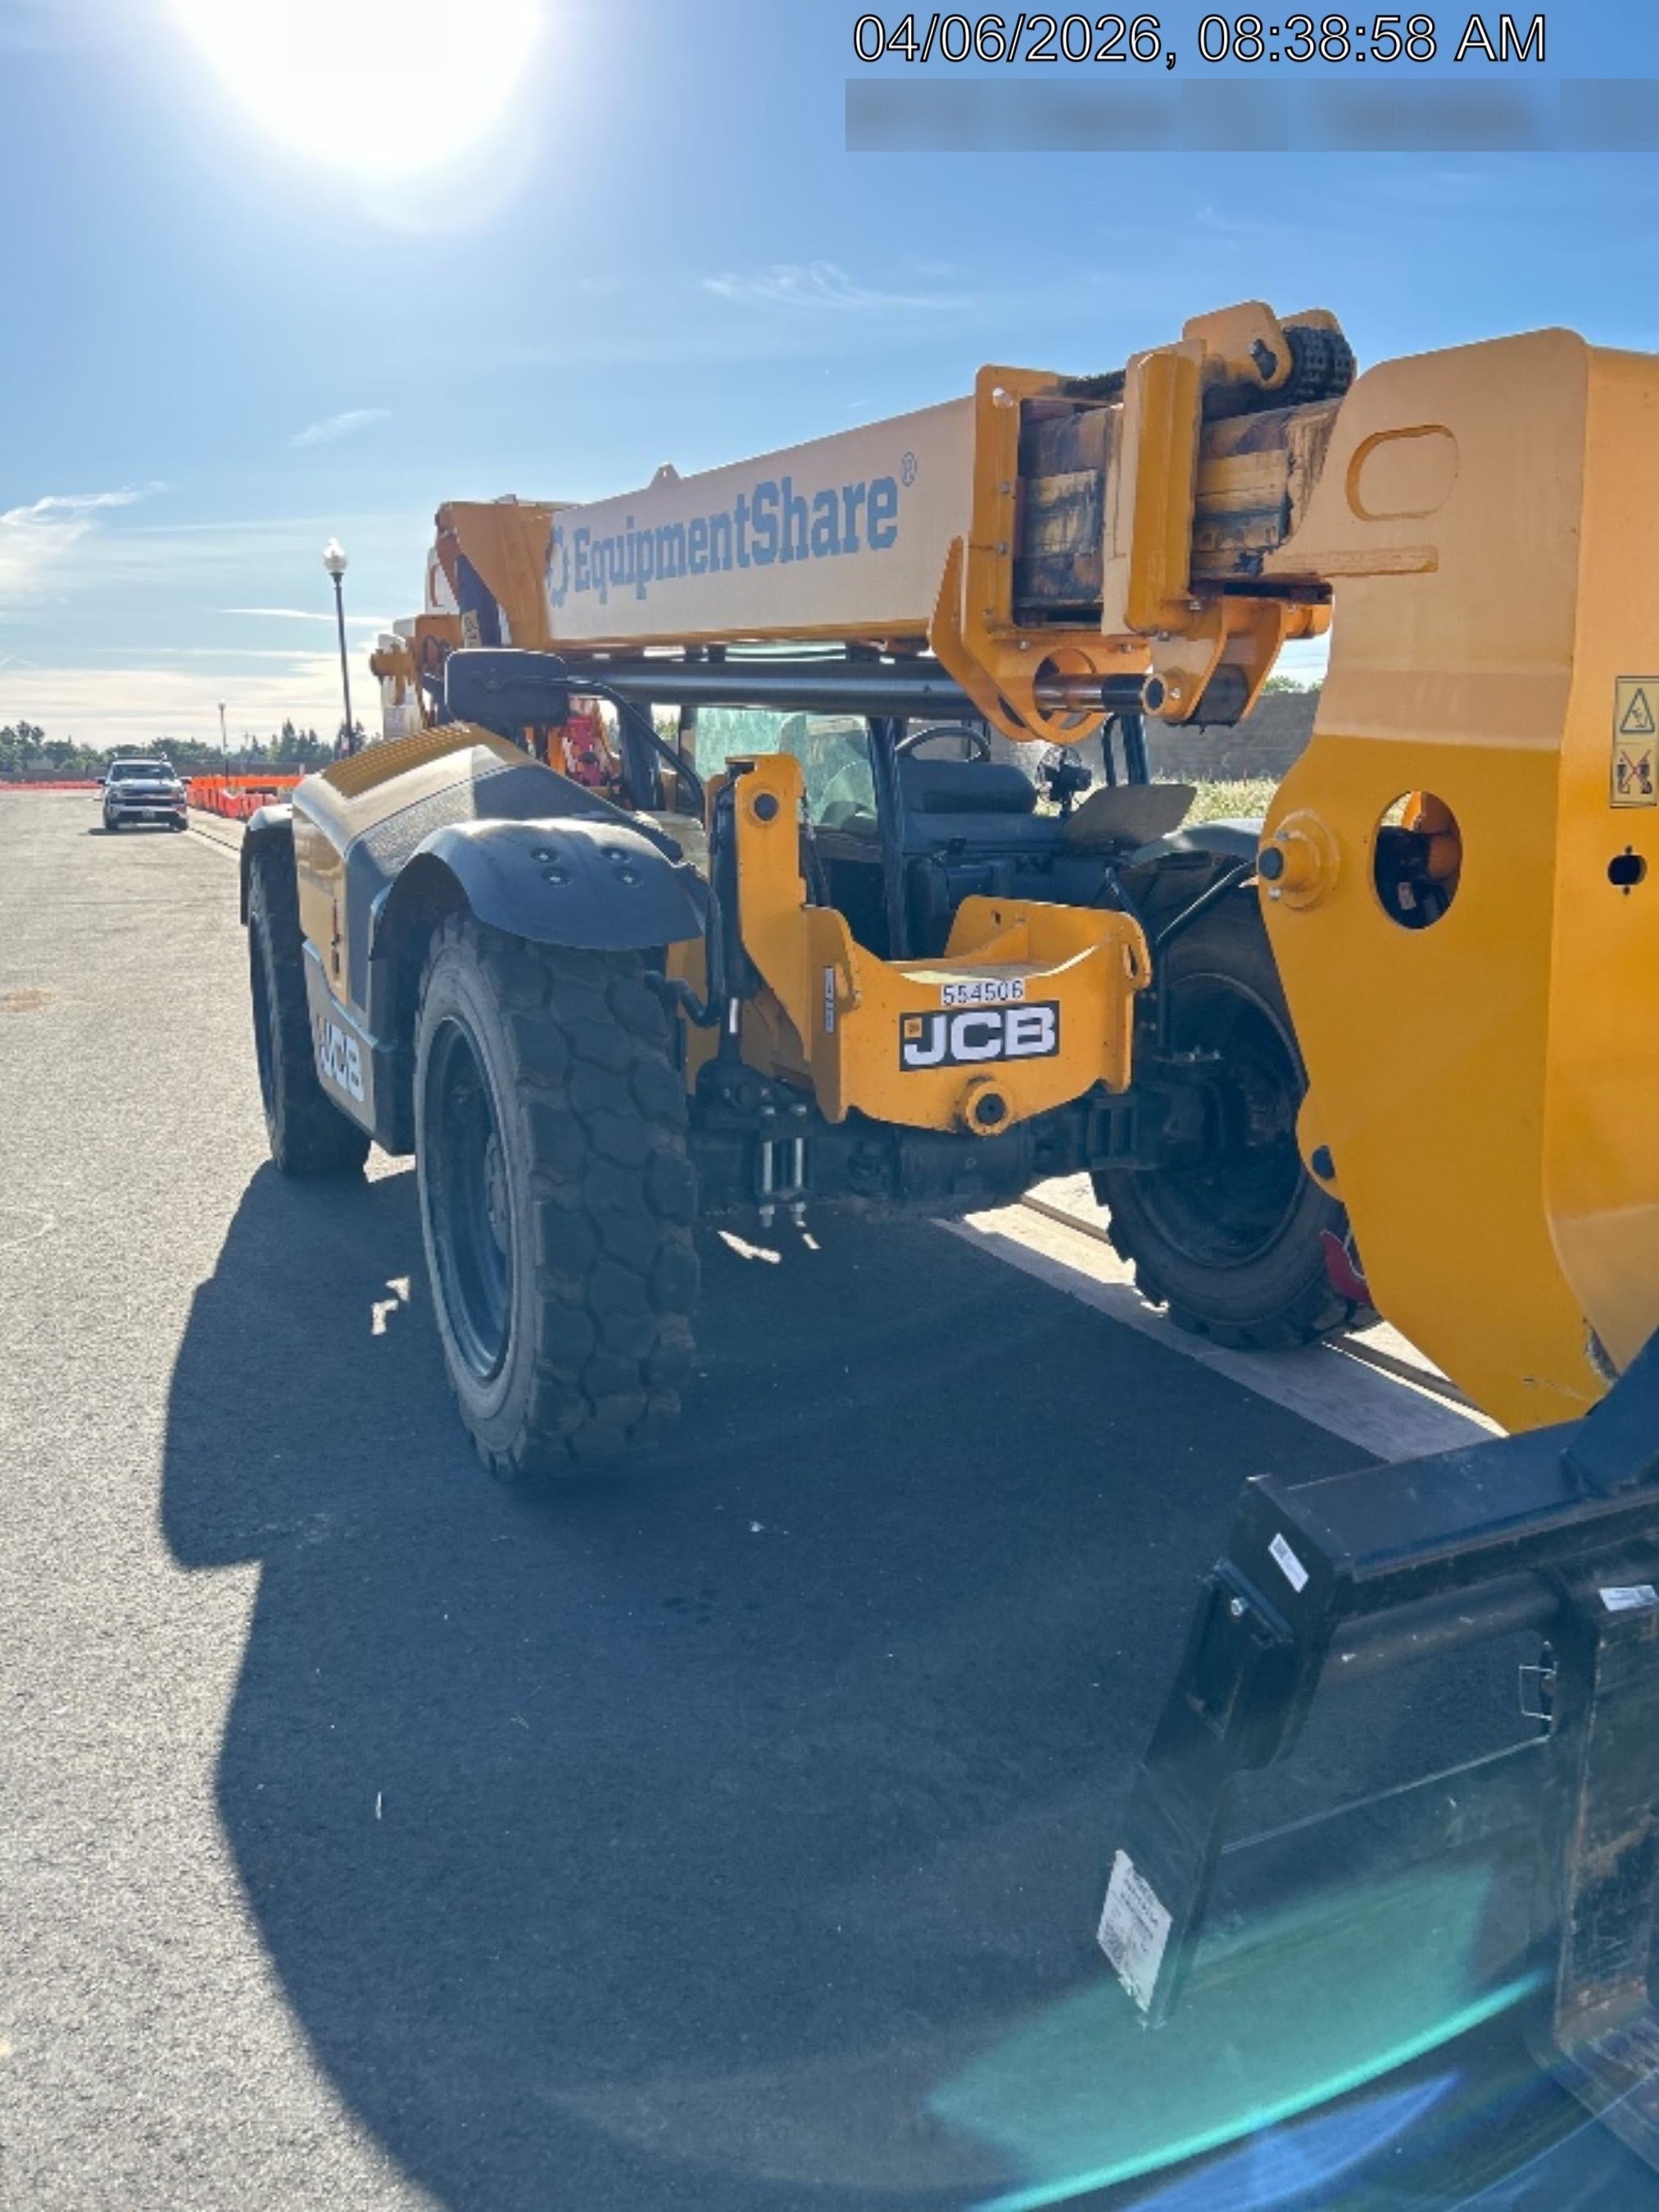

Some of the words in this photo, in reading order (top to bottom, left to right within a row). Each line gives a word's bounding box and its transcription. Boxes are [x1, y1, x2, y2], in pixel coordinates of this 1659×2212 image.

[943, 980, 1023, 1005] 554506
[320, 1021, 365, 1102] JCB
[904, 1007, 1056, 1065] JCB
